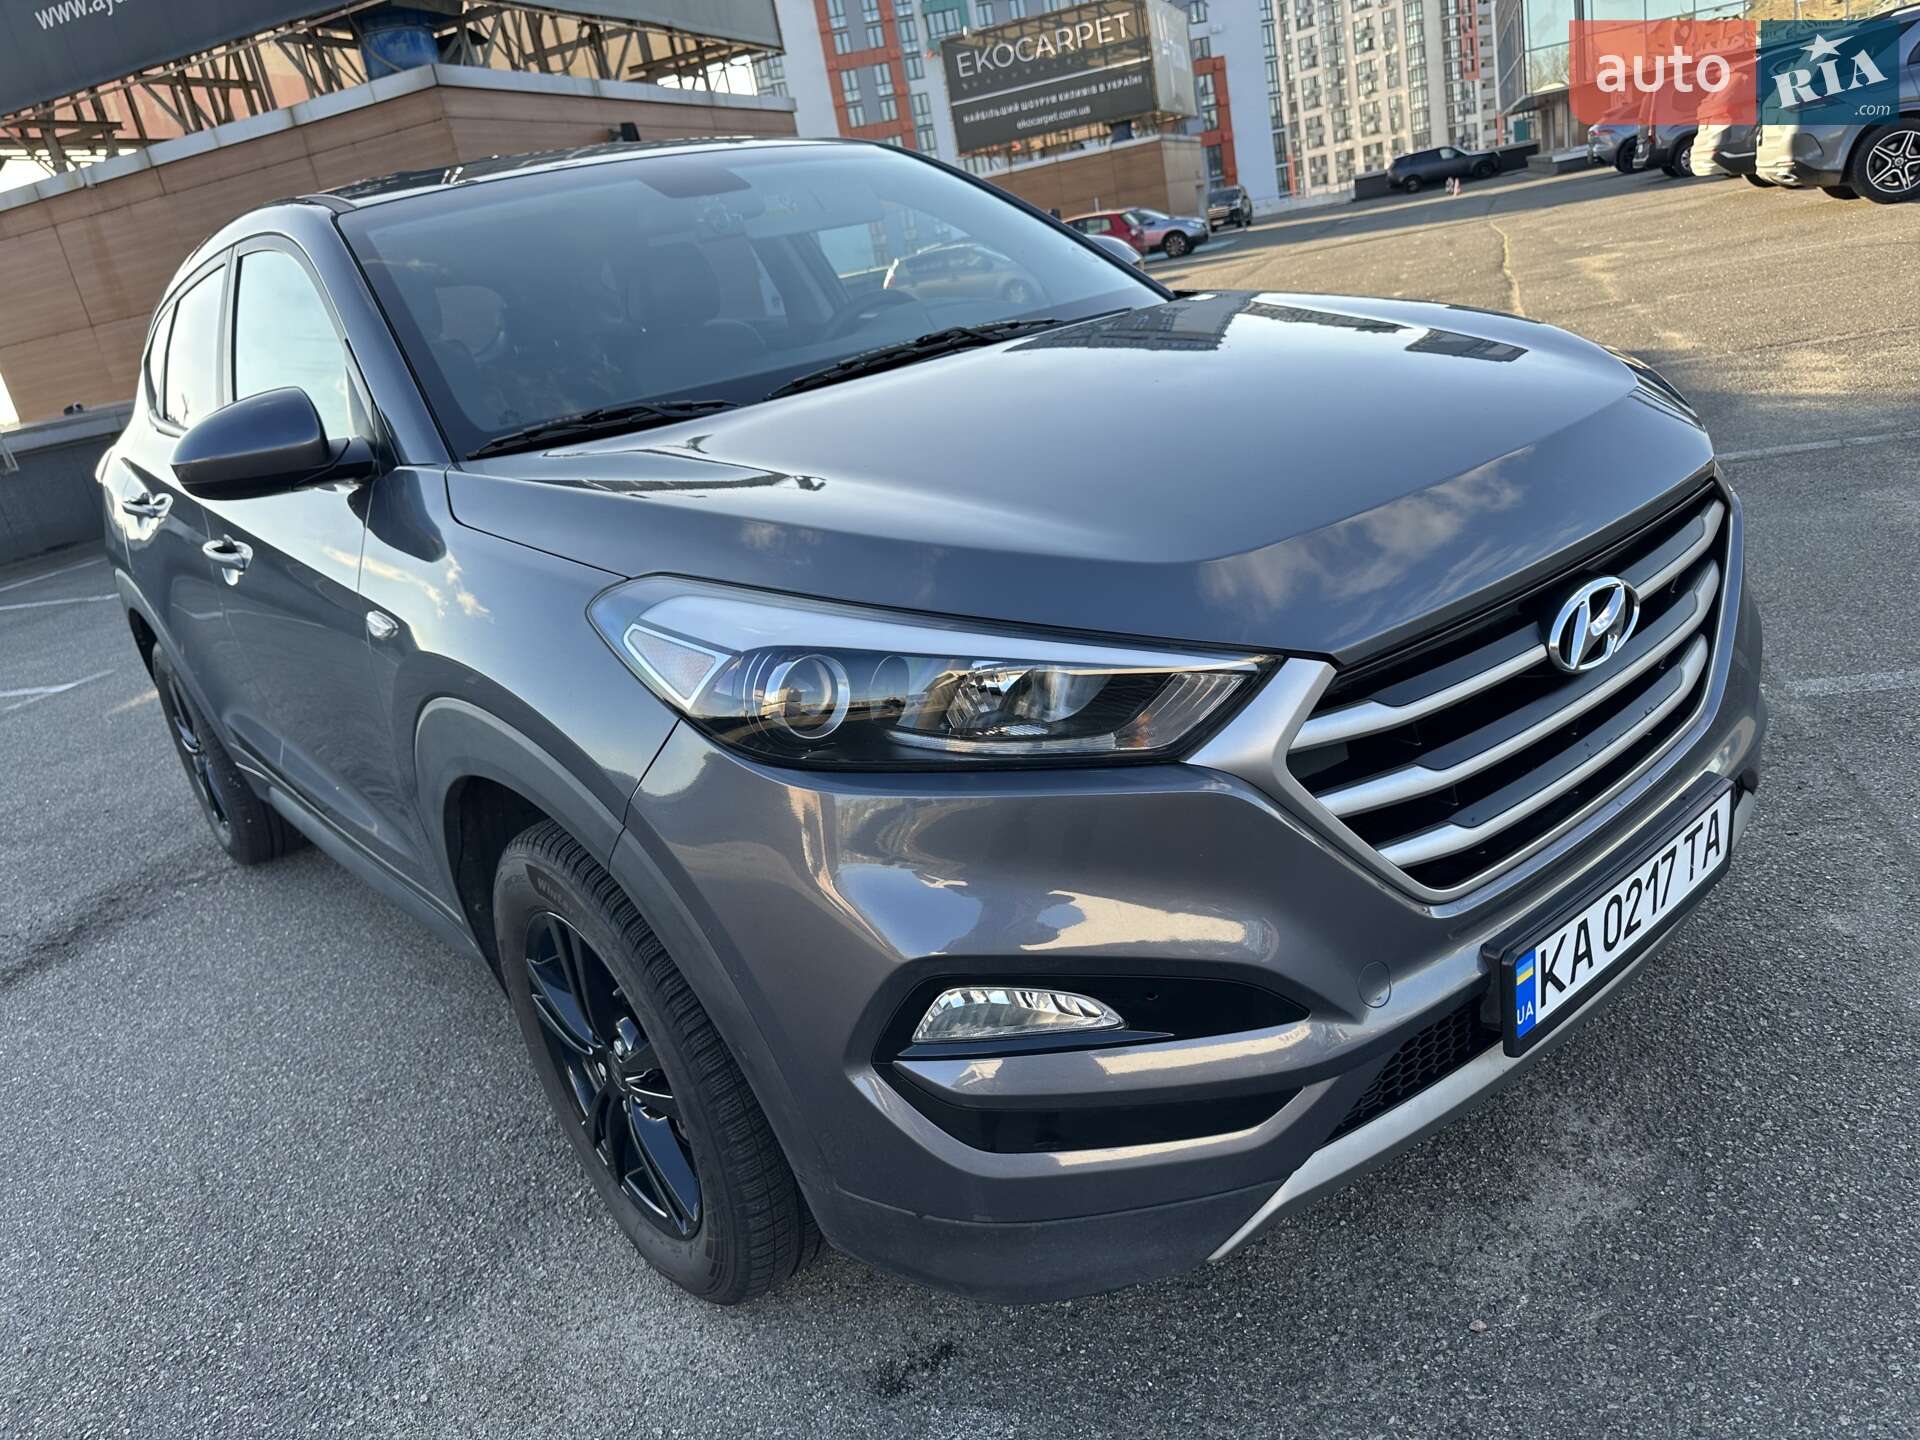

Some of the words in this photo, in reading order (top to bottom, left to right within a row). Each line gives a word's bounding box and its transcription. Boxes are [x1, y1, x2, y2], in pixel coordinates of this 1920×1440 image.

[957, 12, 1130, 77] EKOCARPET
[1016, 105, 1091, 129] ekocarpet.com.ua
[1540, 917, 1594, 1008] KA
[1603, 844, 1677, 952] 0217
[1684, 809, 1720, 882] TA
[1517, 1001, 1534, 1025] UA
